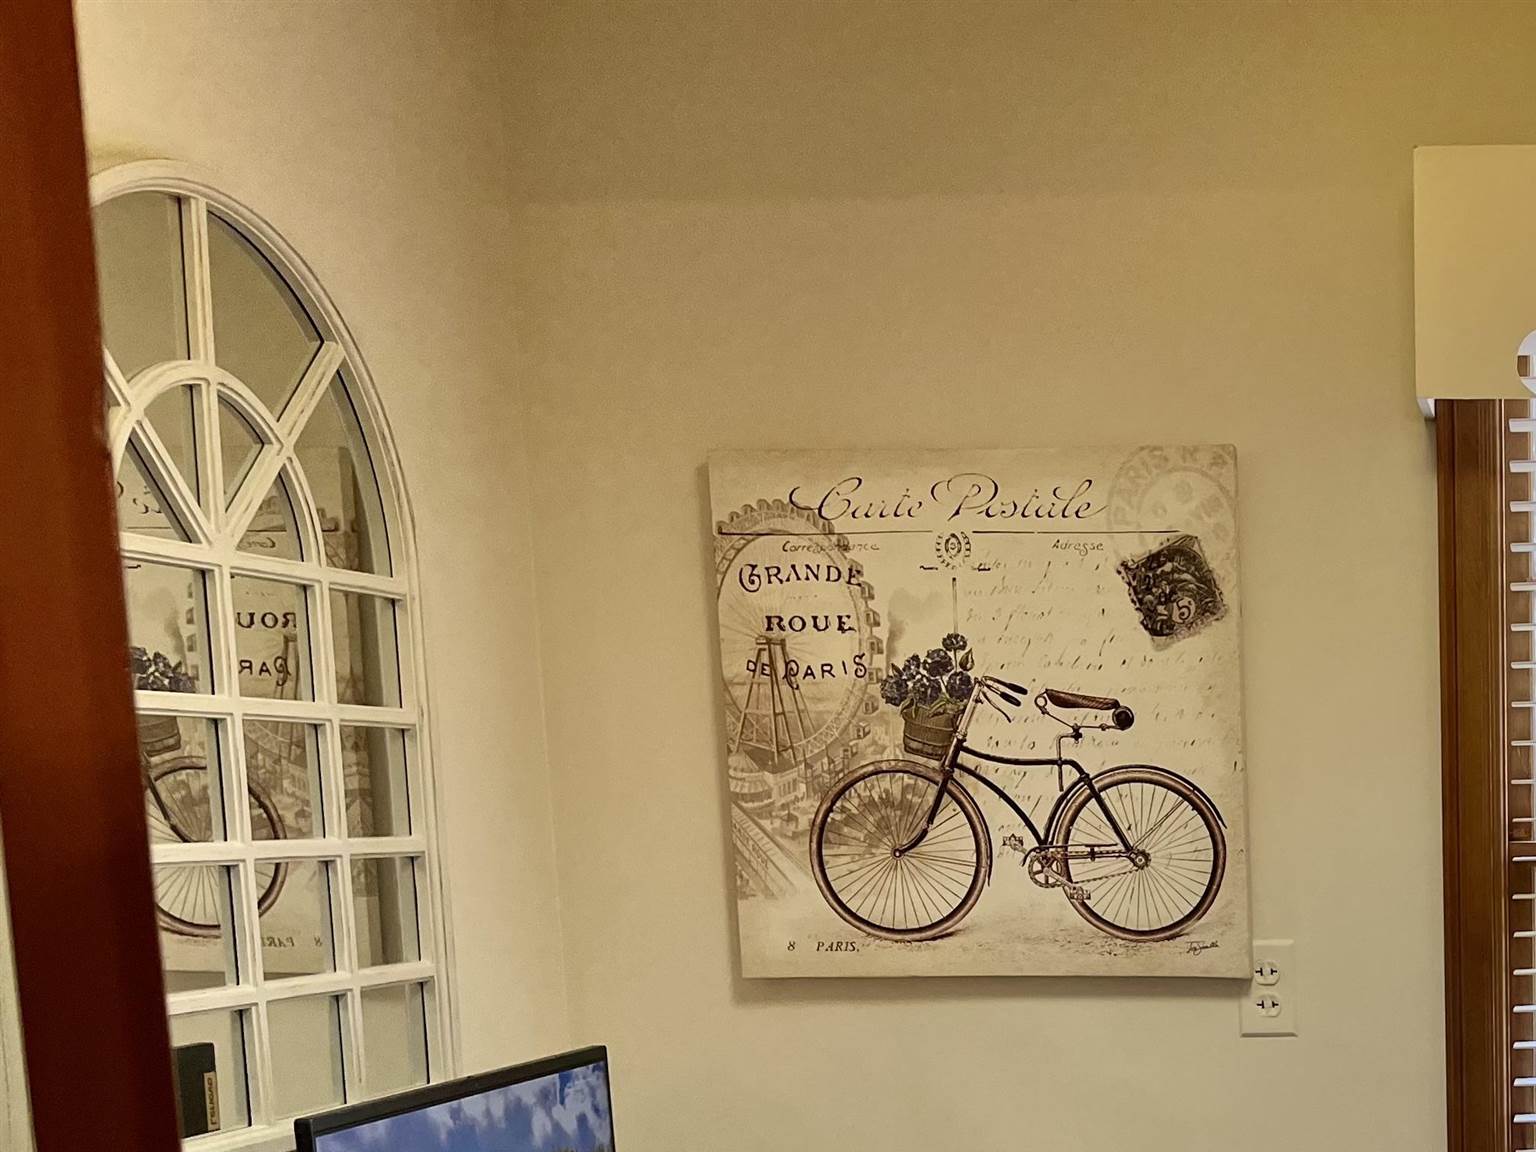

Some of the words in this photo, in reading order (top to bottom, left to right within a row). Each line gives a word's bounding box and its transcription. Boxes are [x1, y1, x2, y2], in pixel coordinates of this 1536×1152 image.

[789, 477, 923, 521] Carte
[931, 473, 1107, 522] Postale
[1051, 539, 1104, 556] Adresse
[739, 563, 863, 593] GRANDE
[765, 615, 857, 633] ROUE
[746, 659, 771, 676] DE
[782, 653, 867, 690] PARIS
[787, 940, 796, 951] 8
[816, 941, 860, 952] PARIS.
